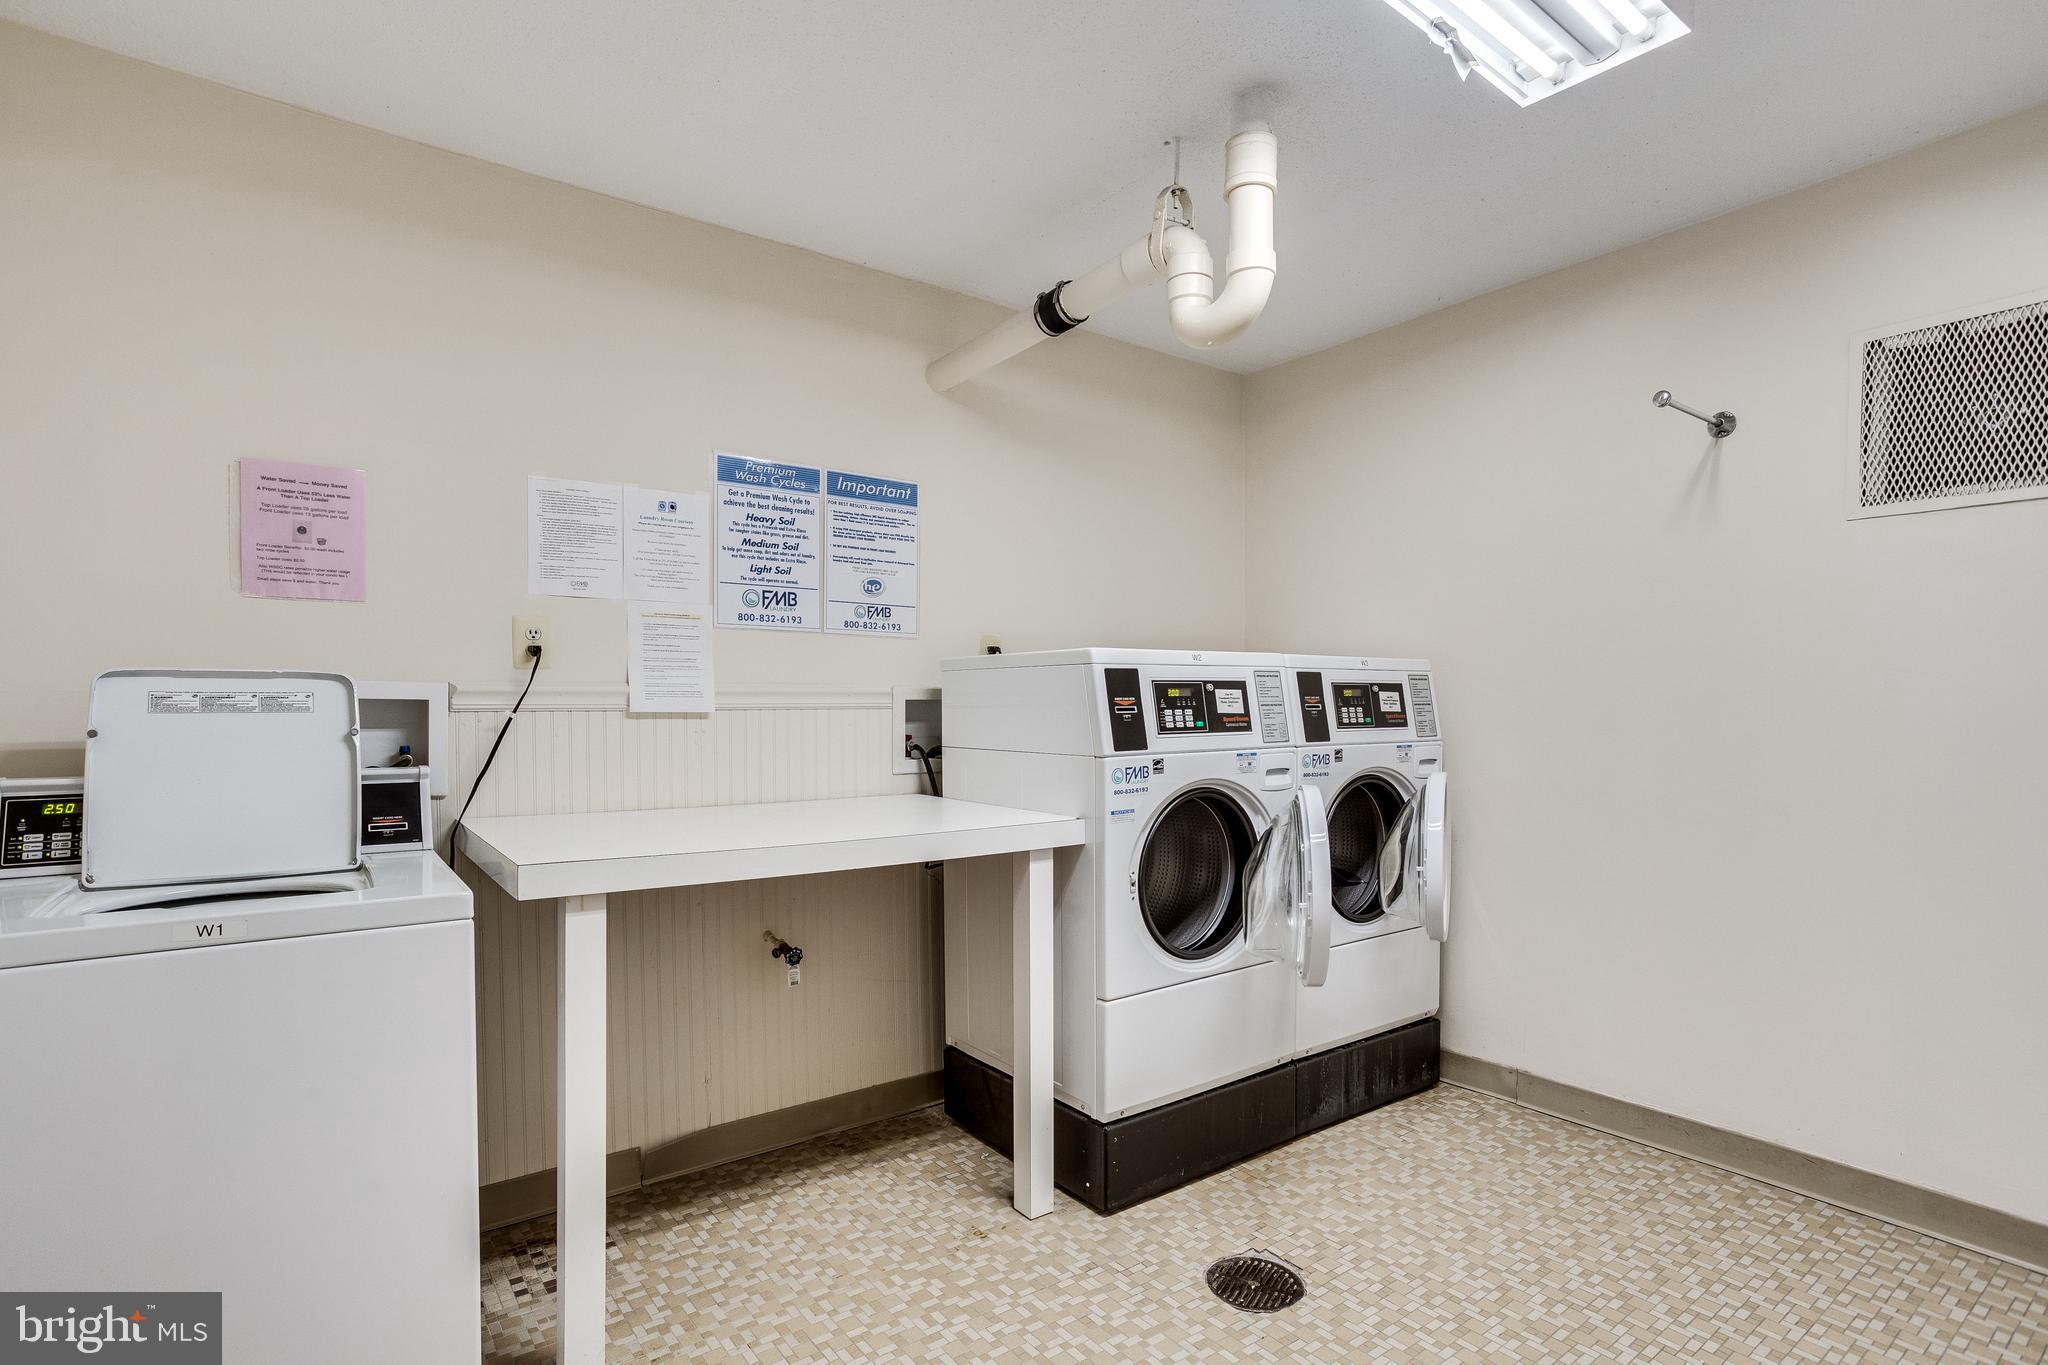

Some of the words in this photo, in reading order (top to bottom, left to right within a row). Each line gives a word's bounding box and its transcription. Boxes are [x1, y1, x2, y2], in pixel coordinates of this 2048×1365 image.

[746, 461, 796, 476] Premium
[736, 470, 766, 482] Wash
[771, 476, 806, 488] Cycles
[837, 476, 911, 499] Important
[746, 490, 770, 499] Premium
[772, 494, 787, 502] Wash
[789, 496, 802, 504] Cycle
[772, 504, 792, 514] cleaning
[850, 502, 868, 510] RESULTS,
[746, 513, 776, 525] Heavy
[778, 517, 796, 526] Soil
[742, 538, 779, 549] Medium
[782, 542, 799, 550] Soil
[750, 564, 772, 575] Light
[774, 566, 792, 575] Soil
[762, 590, 798, 609] FMB
[738, 613, 802, 624] 800-832-6193
[868, 606, 891, 620] FMB
[844, 620, 901, 631] 800-832-6193
[1312, 754, 1330, 768] FMB
[1125, 766, 1149, 784] FMB
[1114, 787, 1148, 795] 800-832-6193
[44, 804, 74, 814] 2.50
[196, 924, 222, 937] W1
